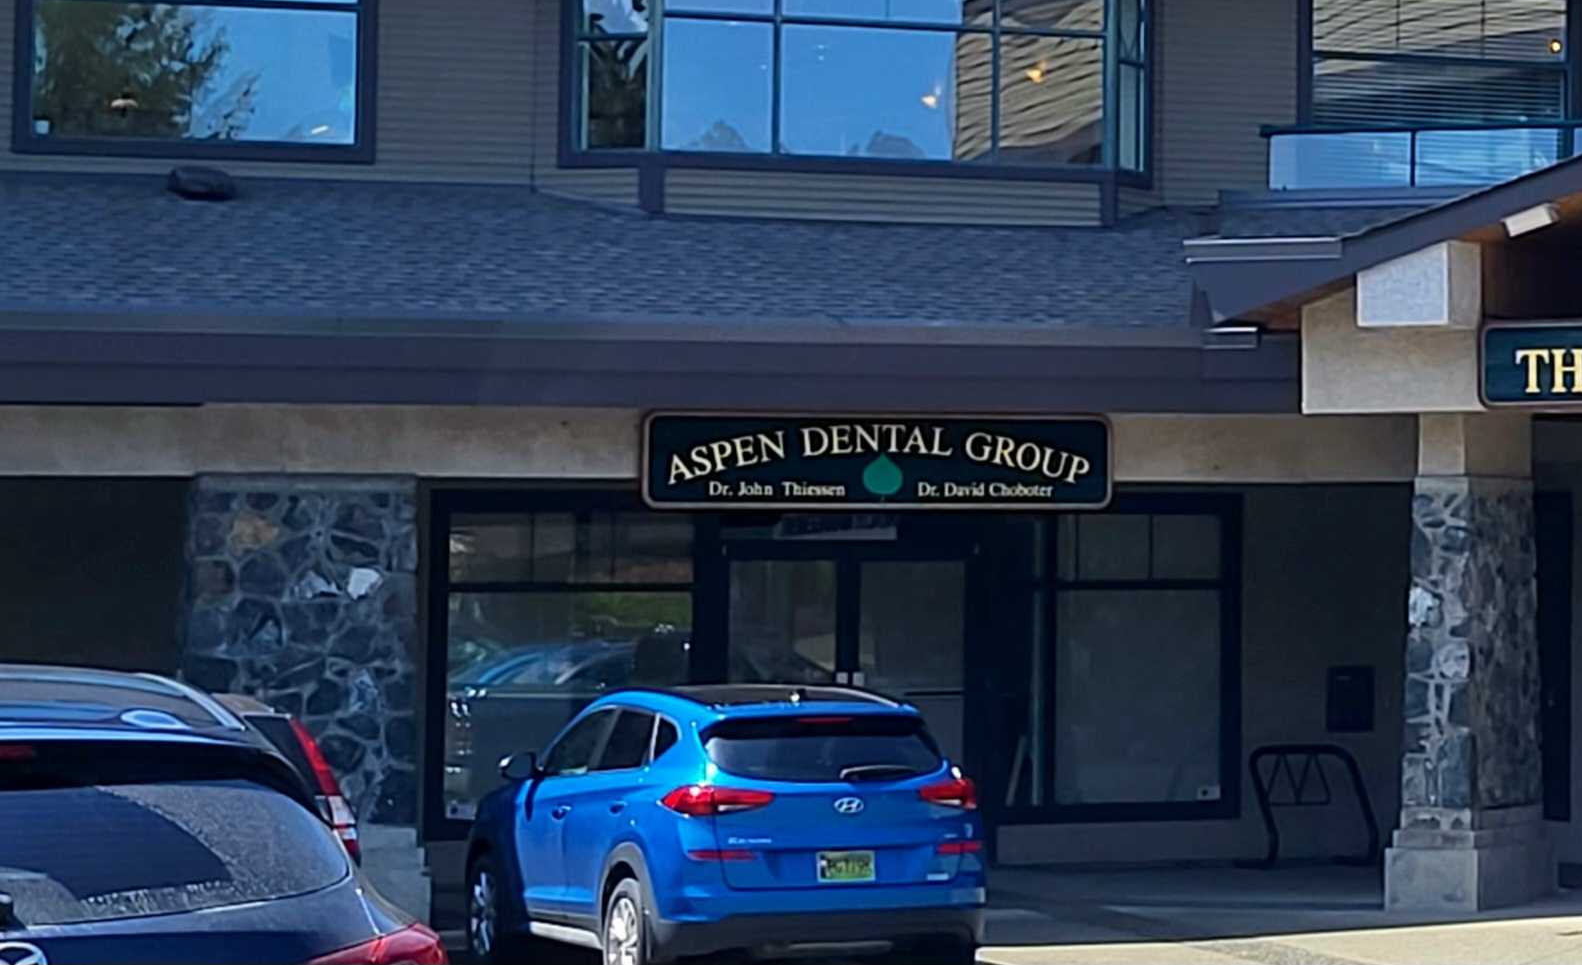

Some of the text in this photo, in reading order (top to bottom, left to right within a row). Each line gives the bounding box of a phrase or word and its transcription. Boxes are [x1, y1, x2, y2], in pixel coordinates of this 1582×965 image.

[668, 424, 1090, 485] ASPEN DENTAL GROUP
[709, 480, 845, 498] Dr. John Thiessen
[918, 482, 940, 498] Dr.
[944, 482, 985, 498] David
